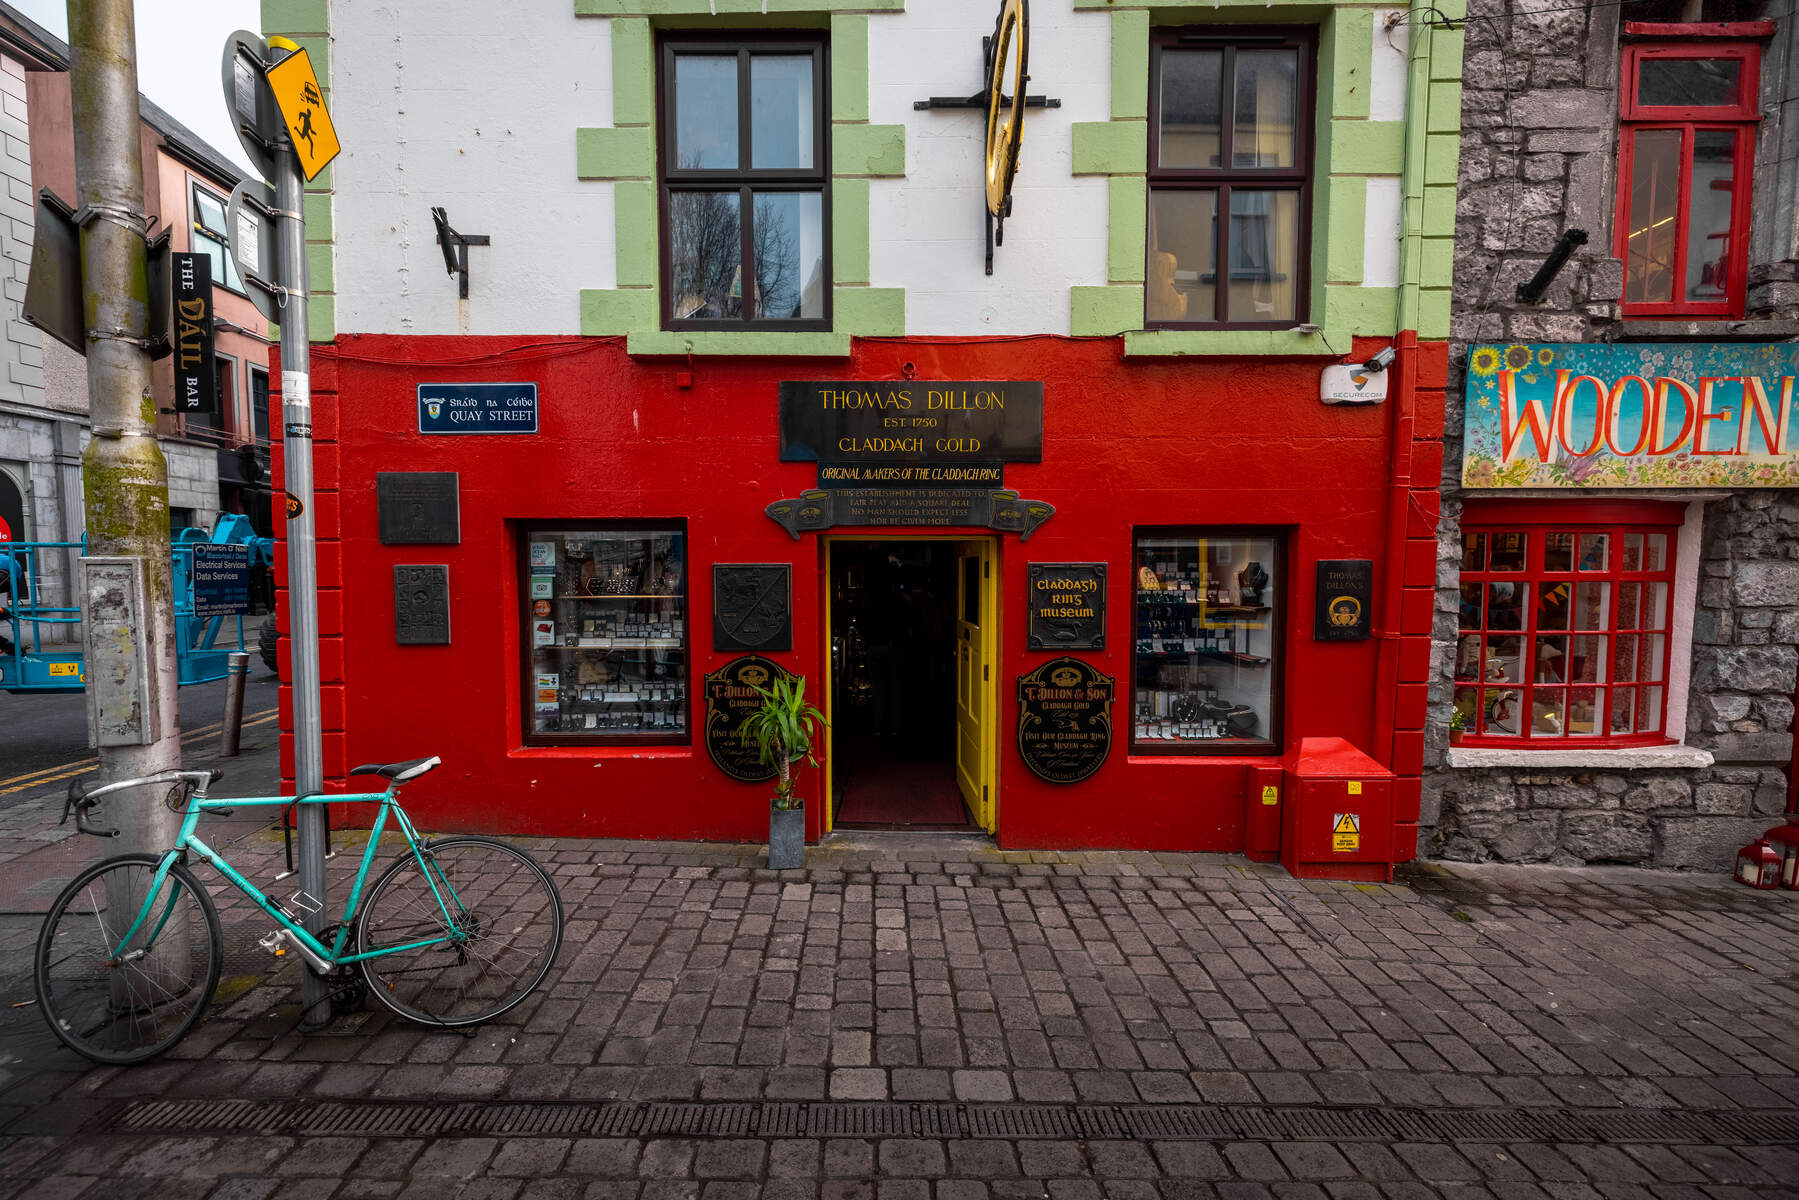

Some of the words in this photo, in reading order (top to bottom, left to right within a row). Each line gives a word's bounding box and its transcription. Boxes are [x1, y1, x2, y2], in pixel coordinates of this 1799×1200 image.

[182, 258, 194, 290] THE
[179, 297, 207, 370] DÁIL
[187, 377, 199, 407] BAR
[818, 390, 912, 409] THOMAS
[927, 390, 1004, 410] DILLON
[450, 410, 483, 423] QUAY
[489, 410, 533, 421] STREET
[912, 417, 938, 428] 1750
[1496, 369, 1795, 464] WOODEN
[838, 437, 923, 452] CLADDAGH
[936, 438, 981, 452] GOLD
[822, 467, 860, 480] ORIGINAL
[861, 467, 901, 480] MAKERS
[901, 468, 914, 480] OF
[915, 468, 931, 480] THE
[931, 468, 980, 480] CLADDAGH
[979, 468, 1000, 480] RING
[196, 561, 223, 569] Electrical
[224, 561, 247, 569] Services
[196, 572, 212, 580] Data
[212, 572, 238, 580] Services
